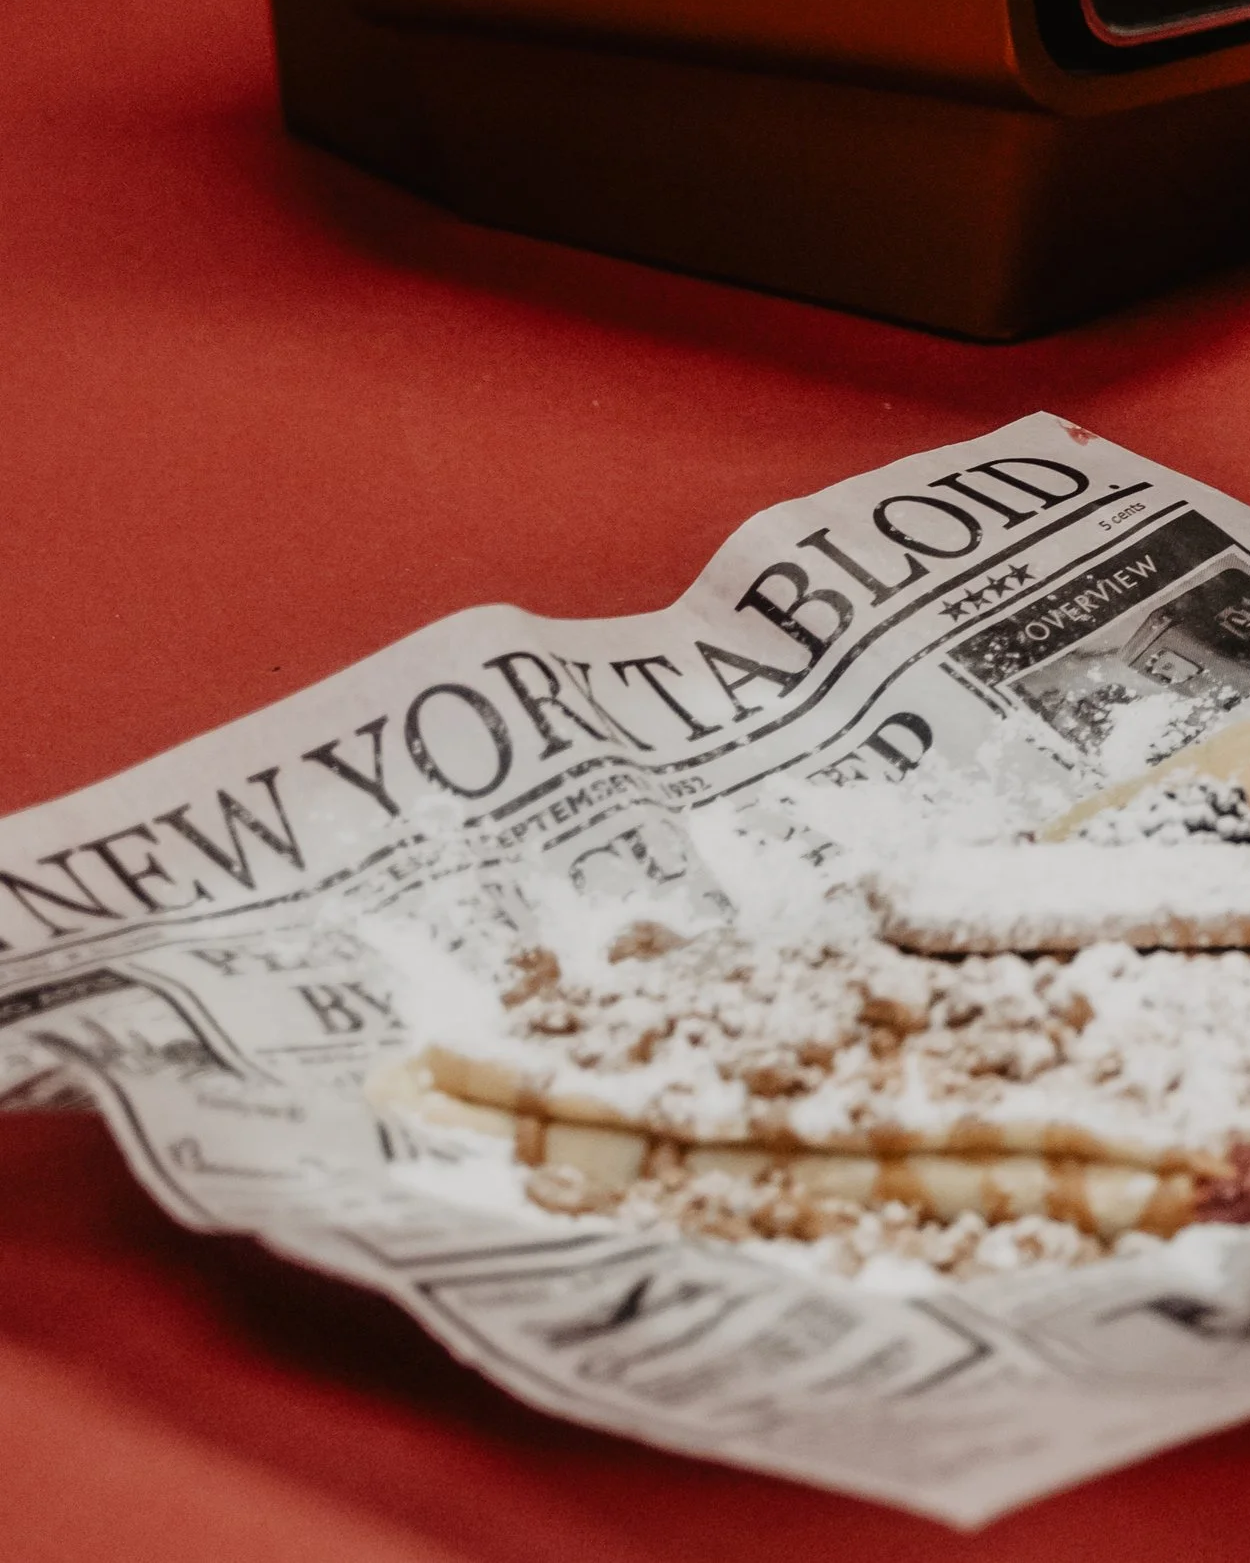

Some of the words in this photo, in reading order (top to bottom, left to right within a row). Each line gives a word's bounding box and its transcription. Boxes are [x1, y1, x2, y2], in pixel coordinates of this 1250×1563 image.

[1098, 520, 1112, 531] 5
[1111, 502, 1146, 524] cents
[1025, 554, 1157, 644] OVERVIEW
[0, 767, 306, 937] NEW
